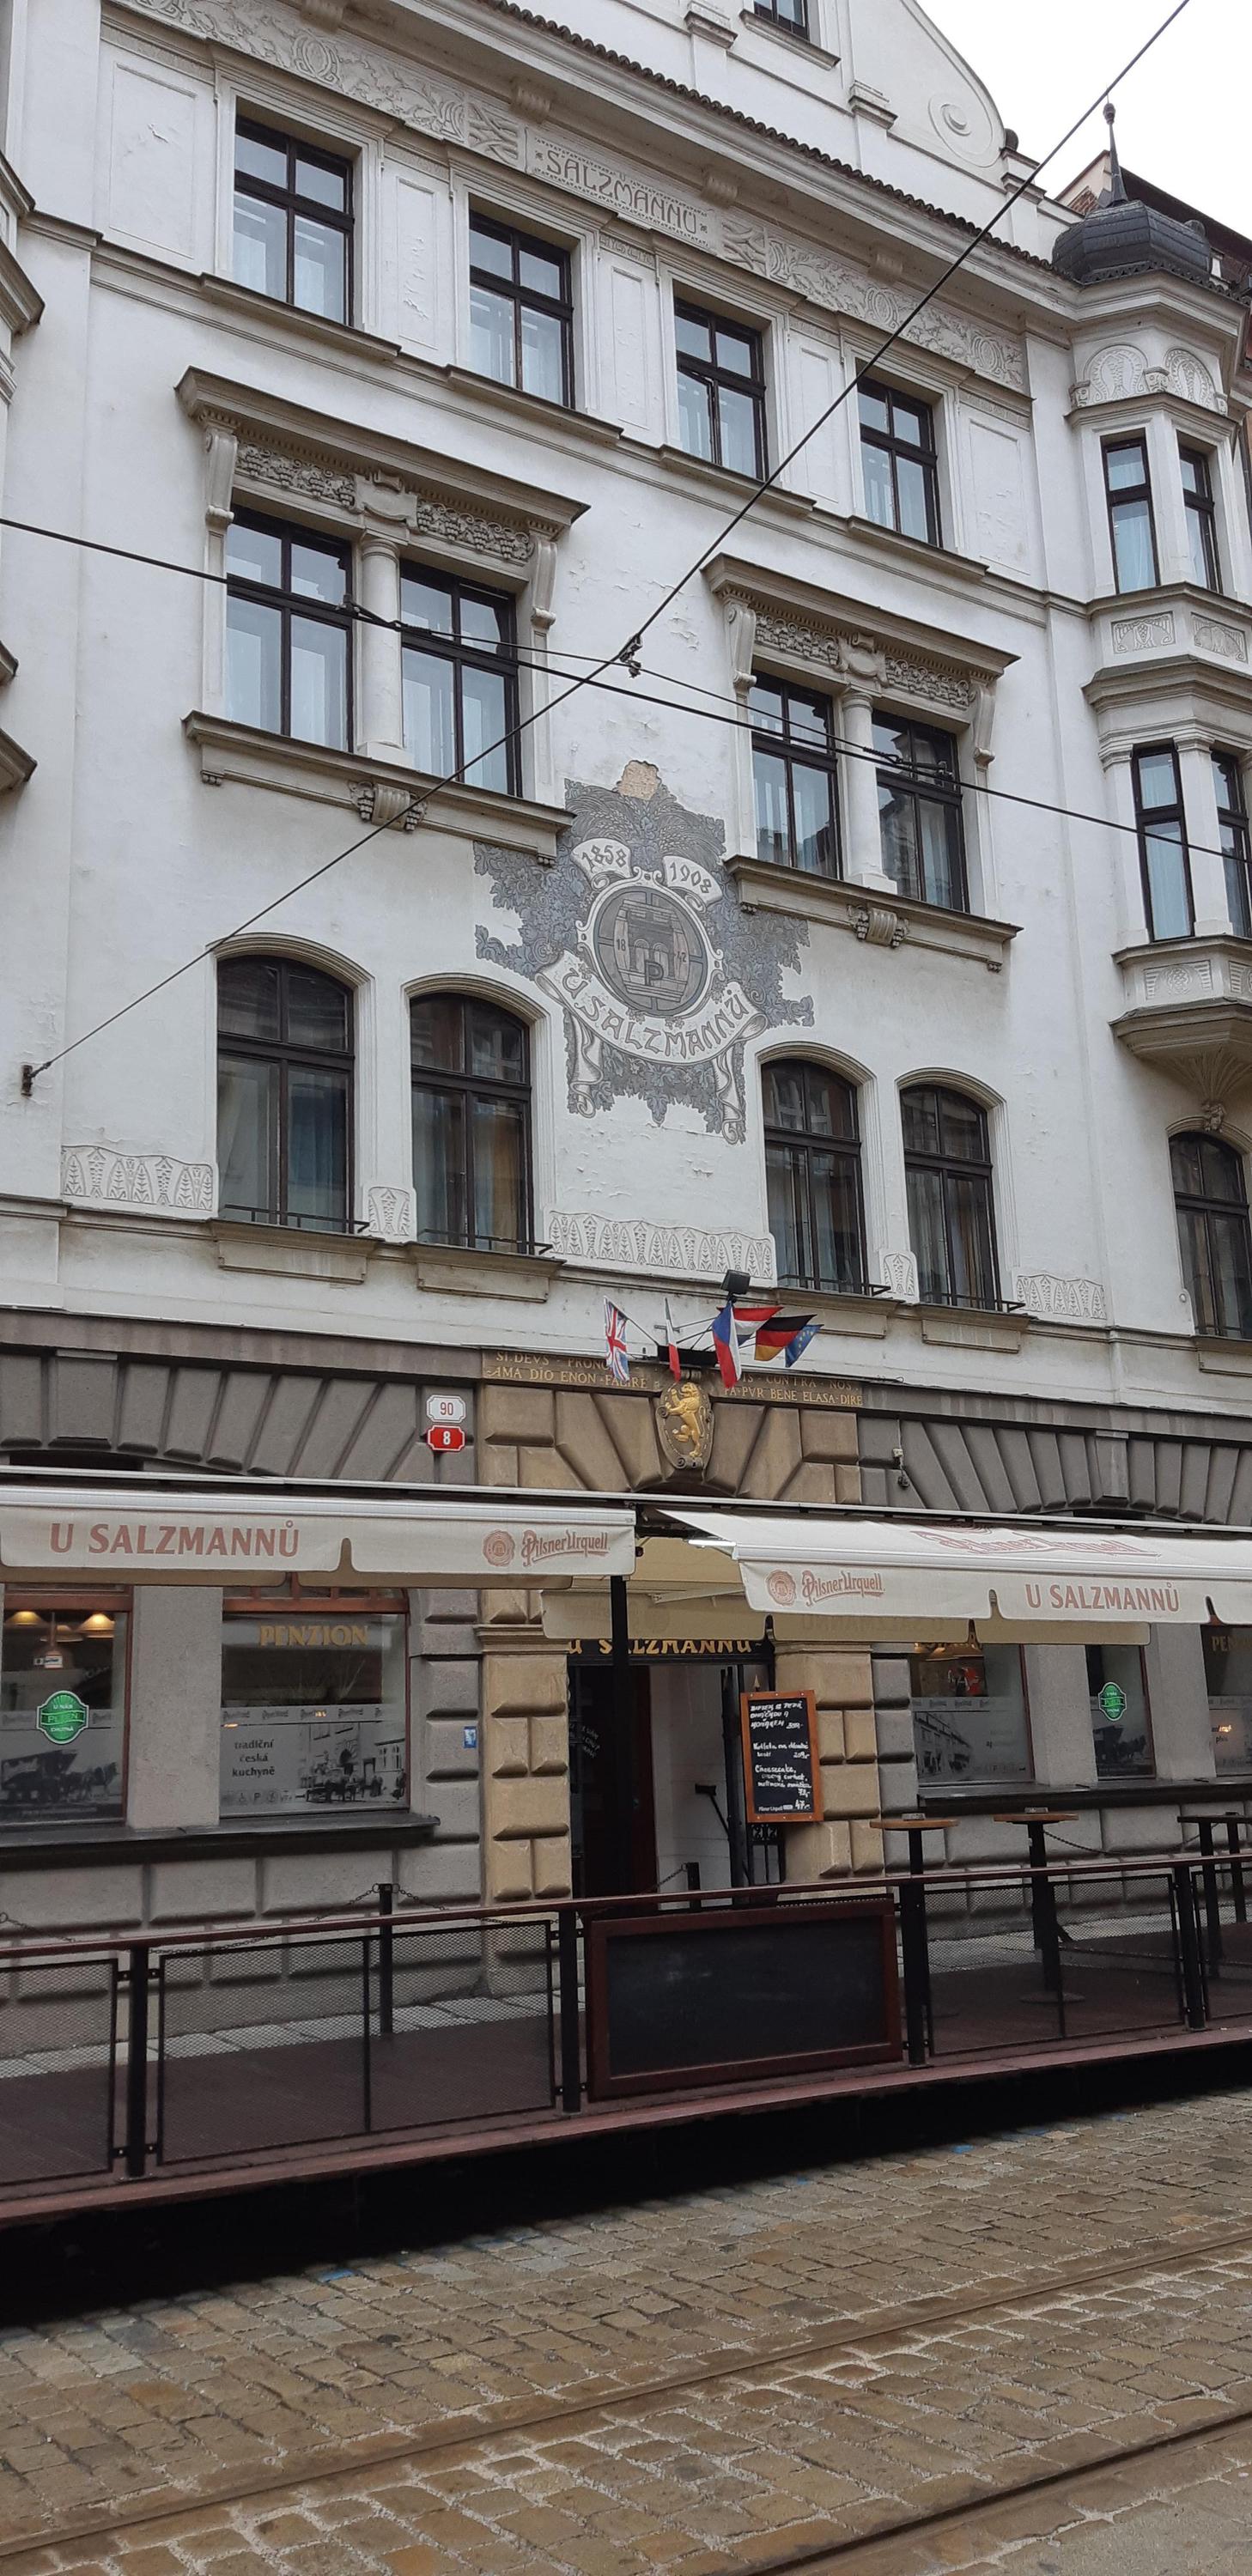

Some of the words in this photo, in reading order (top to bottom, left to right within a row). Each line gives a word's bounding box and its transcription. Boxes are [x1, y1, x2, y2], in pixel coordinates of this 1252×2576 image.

[581, 845, 628, 874] 1858
[670, 861, 713, 894] 1908
[617, 939, 626, 951] 18
[770, 1388, 798, 1401] BENE
[440, 1401, 454, 1416] 90
[443, 1431, 451, 1445] 8
[50, 1522, 75, 1553] U
[88, 1520, 300, 1557] SALZMANNŮ
[520, 1529, 567, 1567] Pilsner
[802, 1570, 843, 1607] Pilsner
[1025, 1583, 1042, 1609] U
[1049, 1582, 1180, 1612] SALZMANNŮ
[259, 1624, 368, 1646] PENZION
[234, 1739, 275, 1749] tradiční
[232, 1765, 276, 1778] kuchyně
